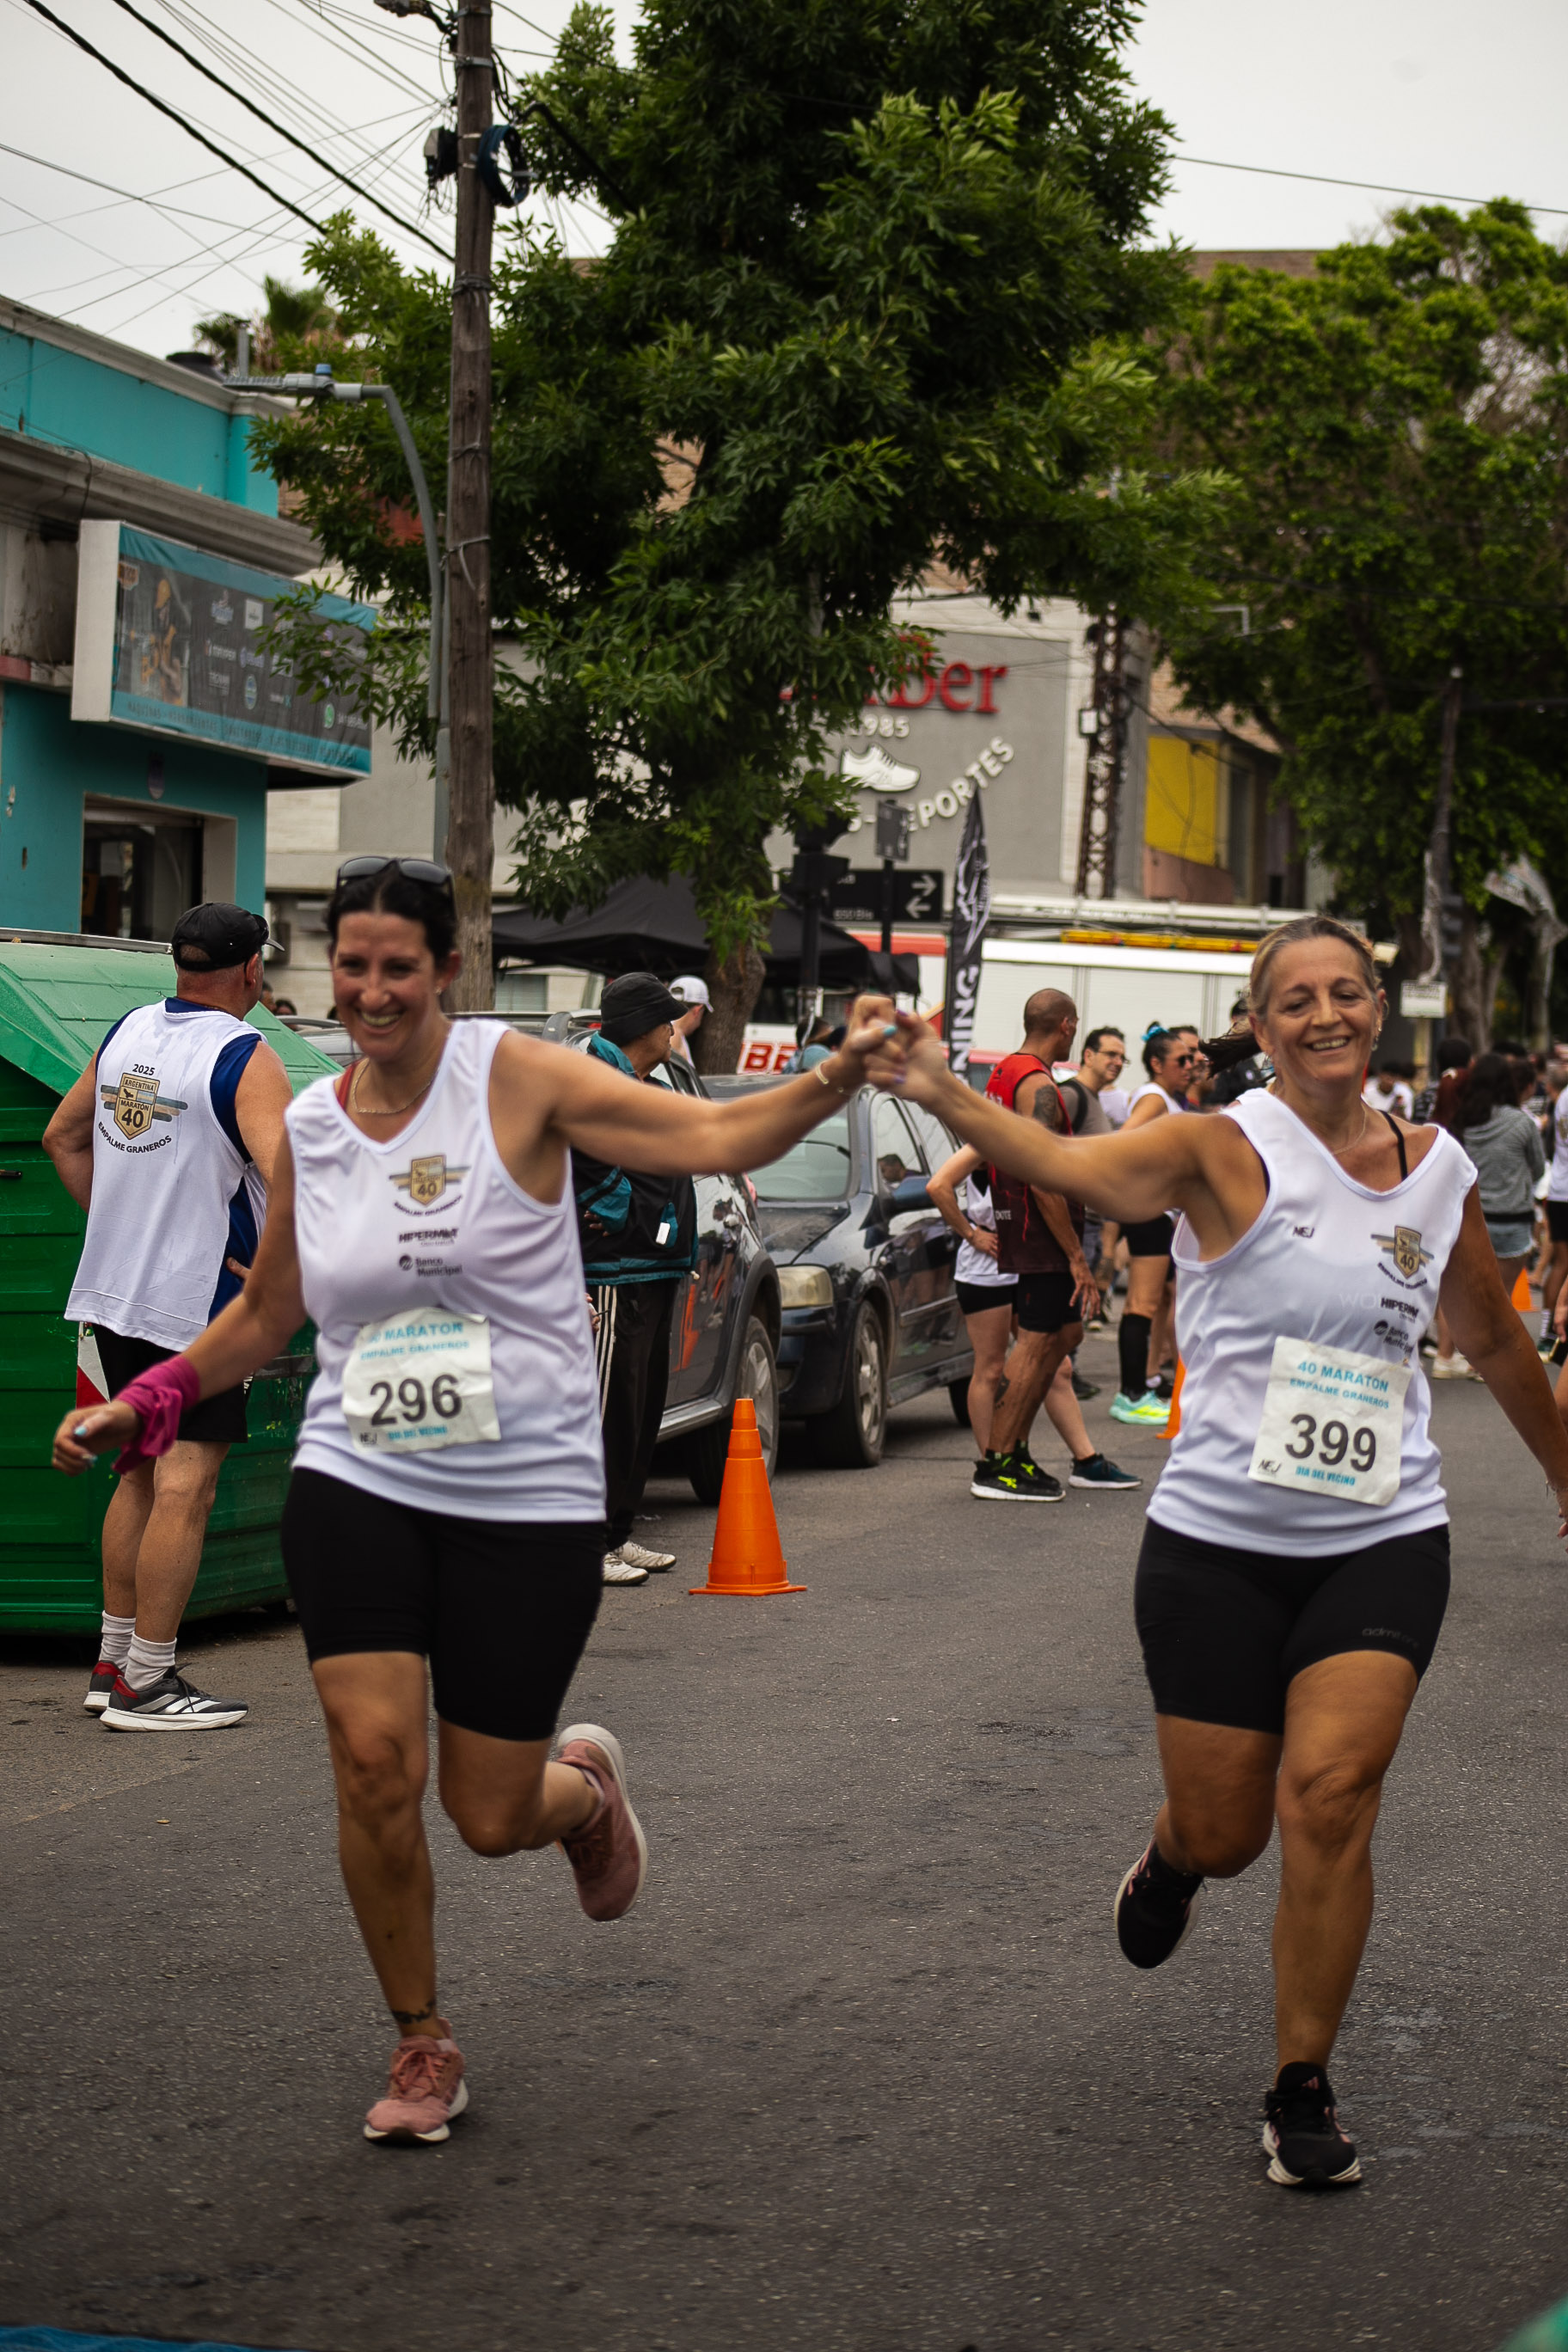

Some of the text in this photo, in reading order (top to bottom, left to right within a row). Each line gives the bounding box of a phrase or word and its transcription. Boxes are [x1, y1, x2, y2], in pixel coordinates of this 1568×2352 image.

[132, 1063, 156, 1076] 2025
[124, 1080, 155, 1092] ARGENTINA
[120, 1108, 144, 1129] 40
[97, 1121, 173, 1154] EMPALME GRANEROS
[417, 1182, 438, 1197] 40
[1400, 1253, 1415, 1271] 40
[383, 1321, 464, 1342] MARATON
[359, 1345, 406, 1361] EMPALME
[1296, 1360, 1389, 1393] 40 MARATON
[369, 1374, 463, 1427] 296
[1289, 1377, 1390, 1410] EMPALME GRANEROS
[1284, 1412, 1377, 1473] 399
[1257, 1458, 1283, 1473] NEJ
[1295, 1465, 1310, 1477] DIA
[1311, 1467, 1326, 1480] DEL
[1326, 1471, 1357, 1486] VECINO
